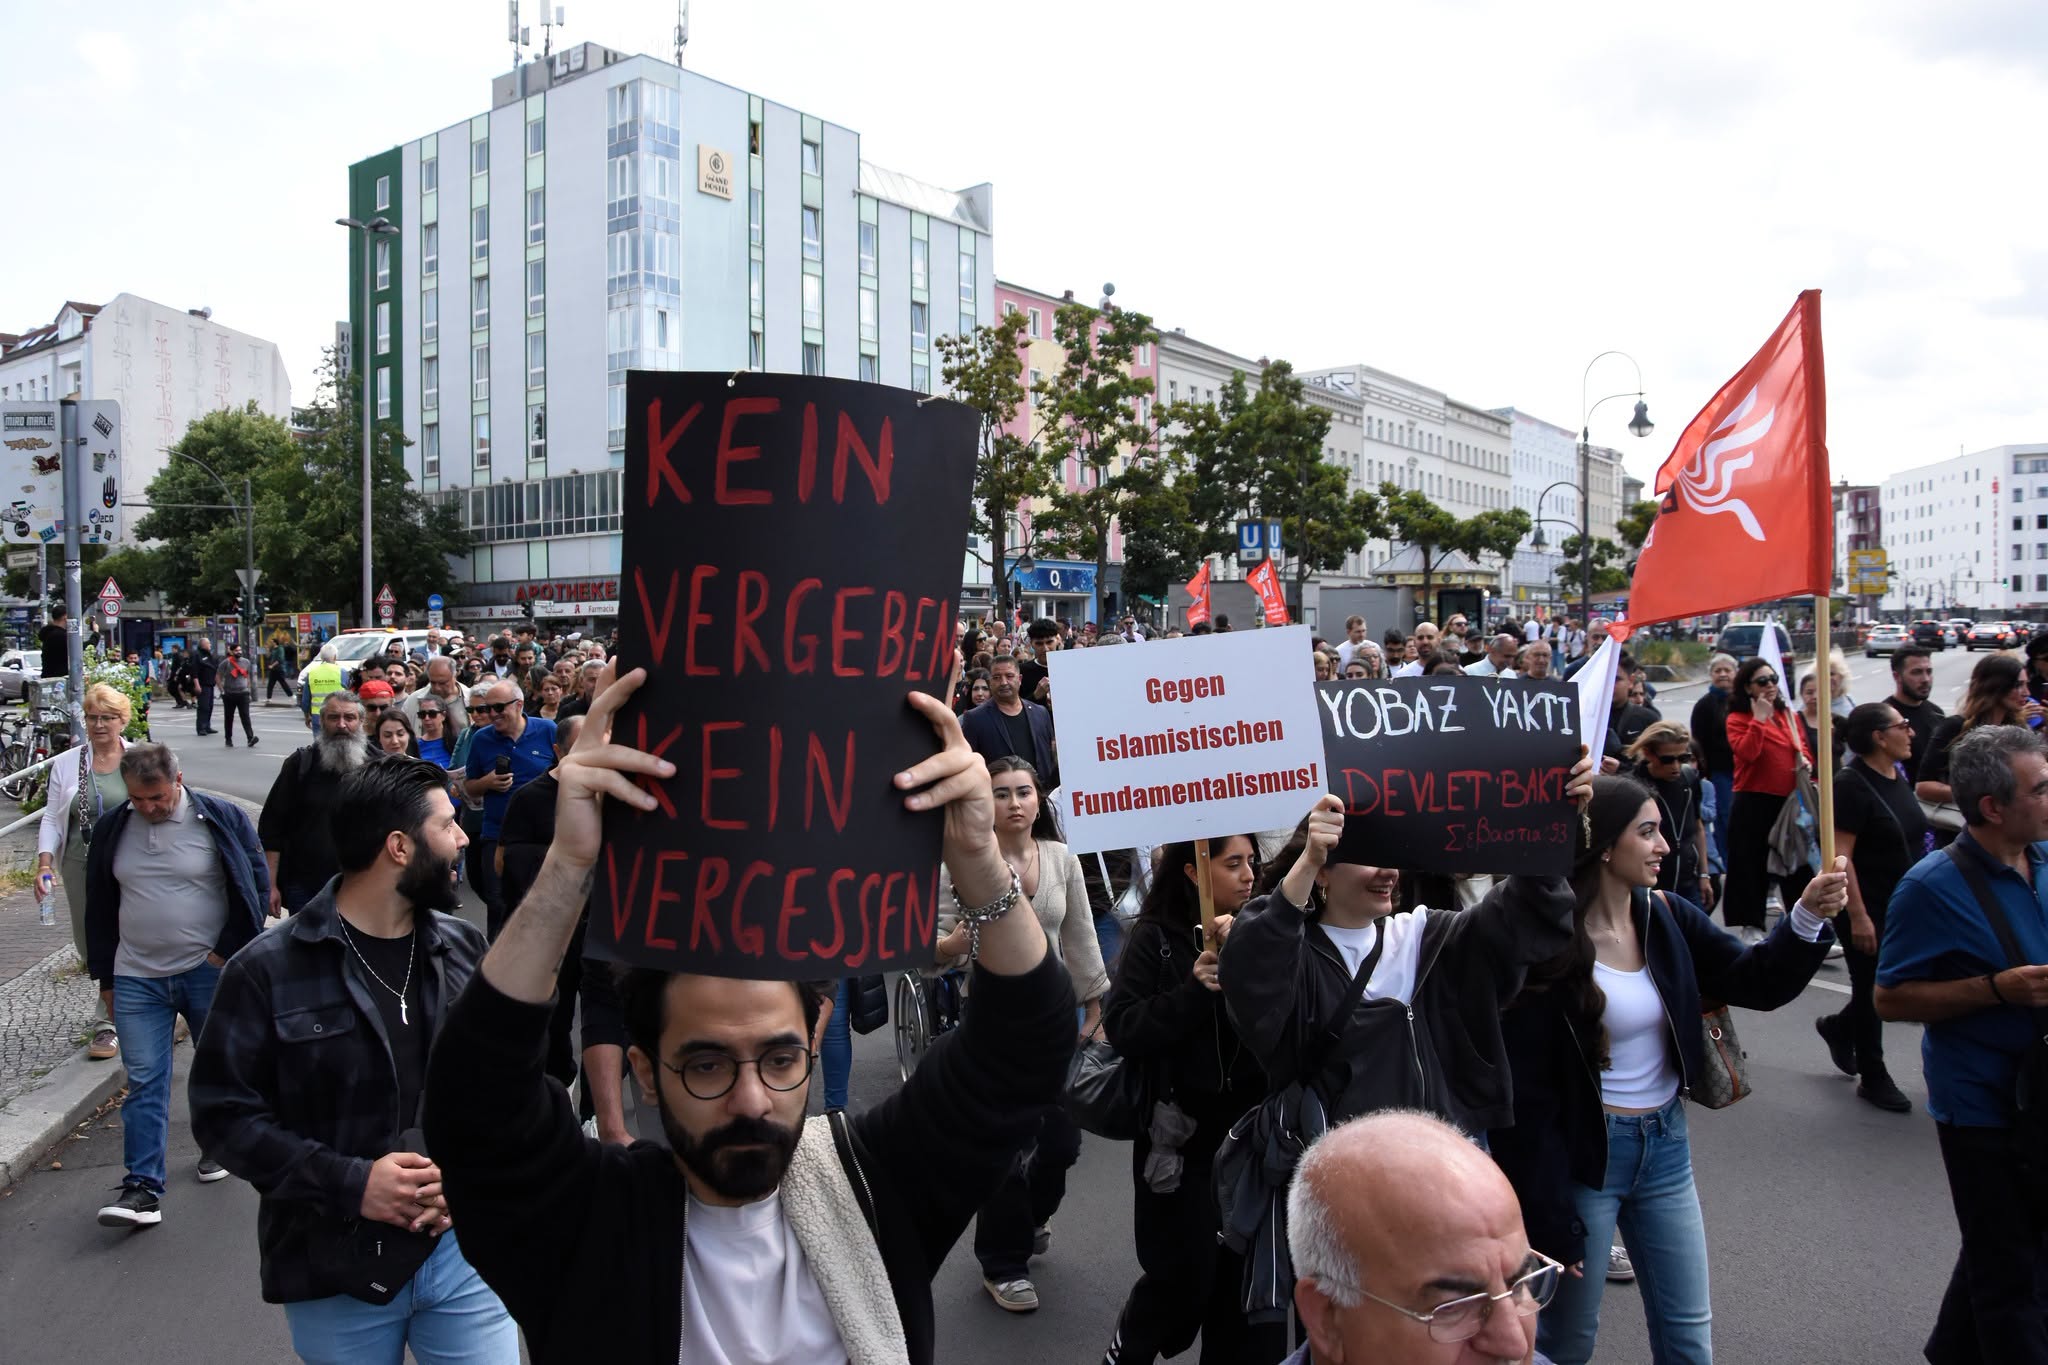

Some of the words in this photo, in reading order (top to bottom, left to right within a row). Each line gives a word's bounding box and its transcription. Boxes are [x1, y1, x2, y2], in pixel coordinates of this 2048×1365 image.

[554, 43, 585, 79] LG
[646, 397, 894, 507] KEIN
[1242, 525, 1259, 548] U
[1270, 525, 1280, 548] U
[107, 603, 117, 612] 30
[515, 581, 617, 602] APOTHEKE
[588, 604, 614, 614] Farmacia
[634, 564, 959, 681] VERGEBEN
[1146, 674, 1226, 704] Gegen
[1320, 686, 1465, 739] YOBAZ
[1482, 685, 1574, 735] YAKTI
[1096, 719, 1284, 762] islamistischen
[635, 711, 857, 833] KEIN
[1071, 762, 1319, 817] Fundamentalismus!
[1341, 768, 1493, 816] DEVLET
[1500, 767, 1579, 809] BAKT
[606, 841, 939, 968] VERGESSEN
